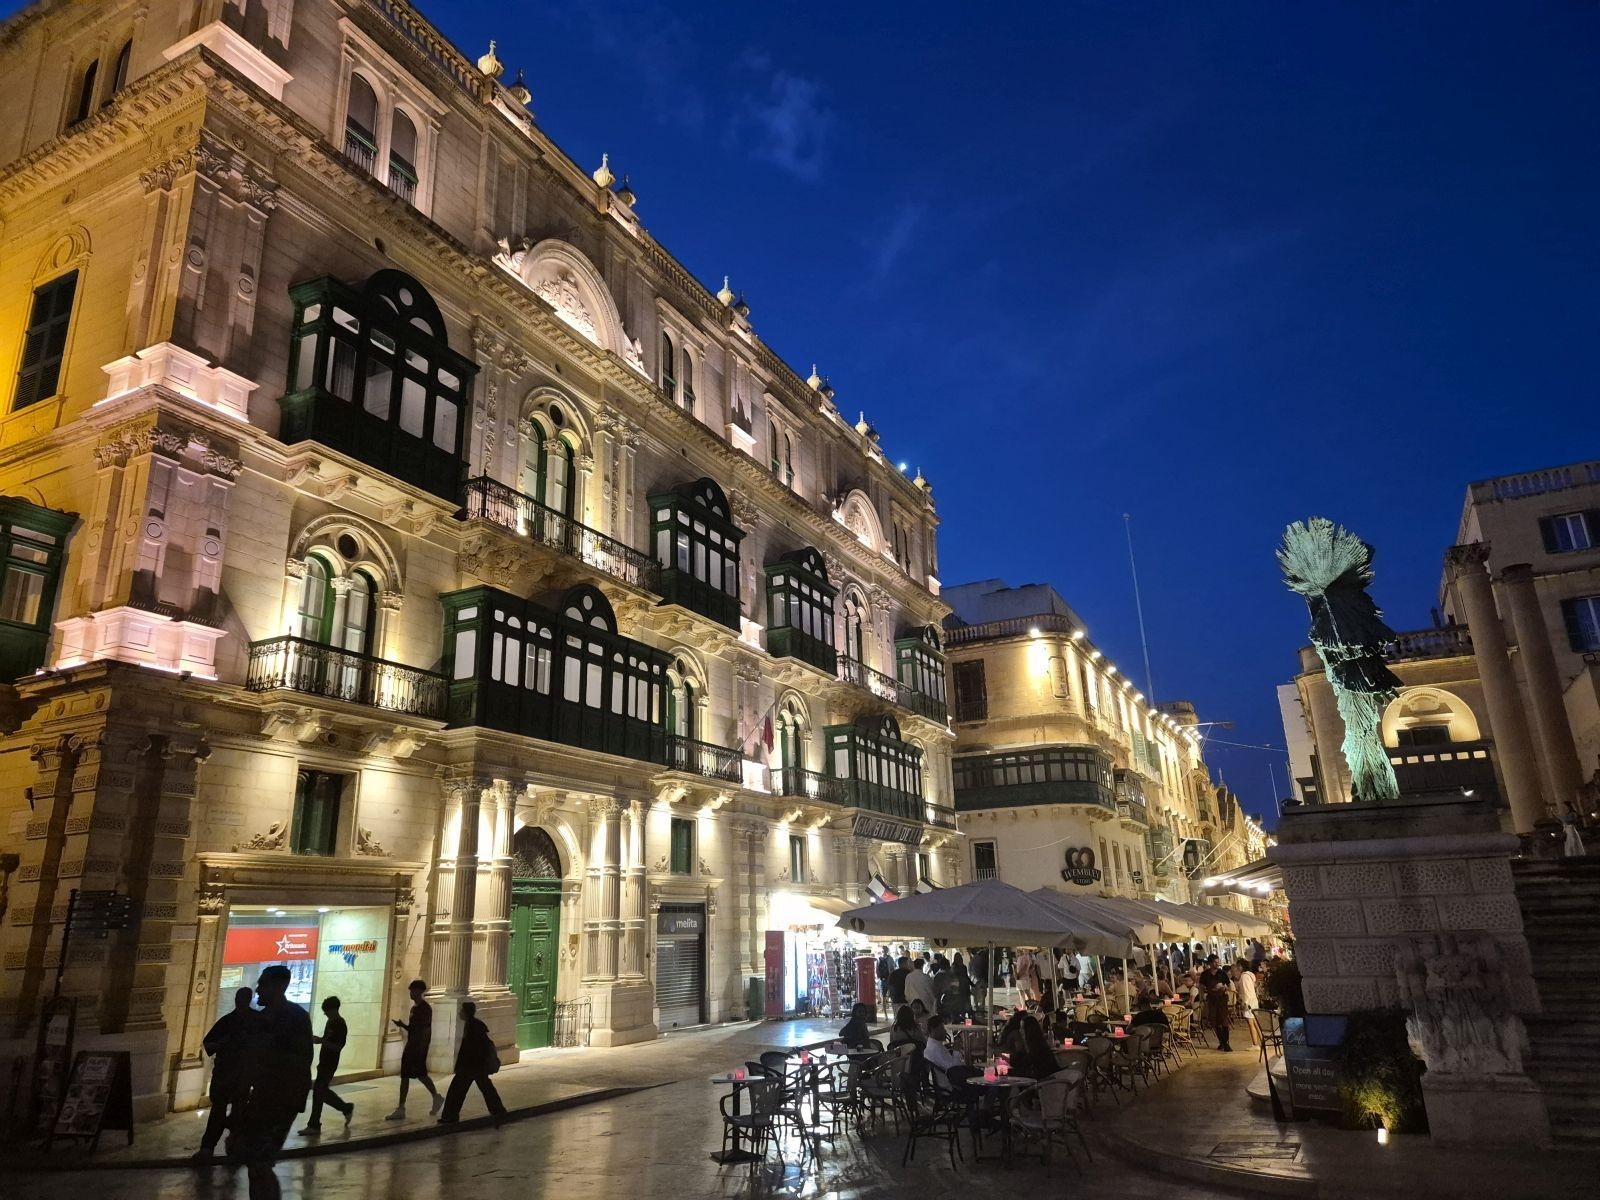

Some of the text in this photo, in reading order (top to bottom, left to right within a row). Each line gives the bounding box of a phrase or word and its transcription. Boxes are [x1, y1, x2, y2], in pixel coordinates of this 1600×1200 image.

[1064, 868, 1100, 879] WEMBLEY
[676, 917, 698, 928] melita
[1293, 1065, 1311, 1075] Open
